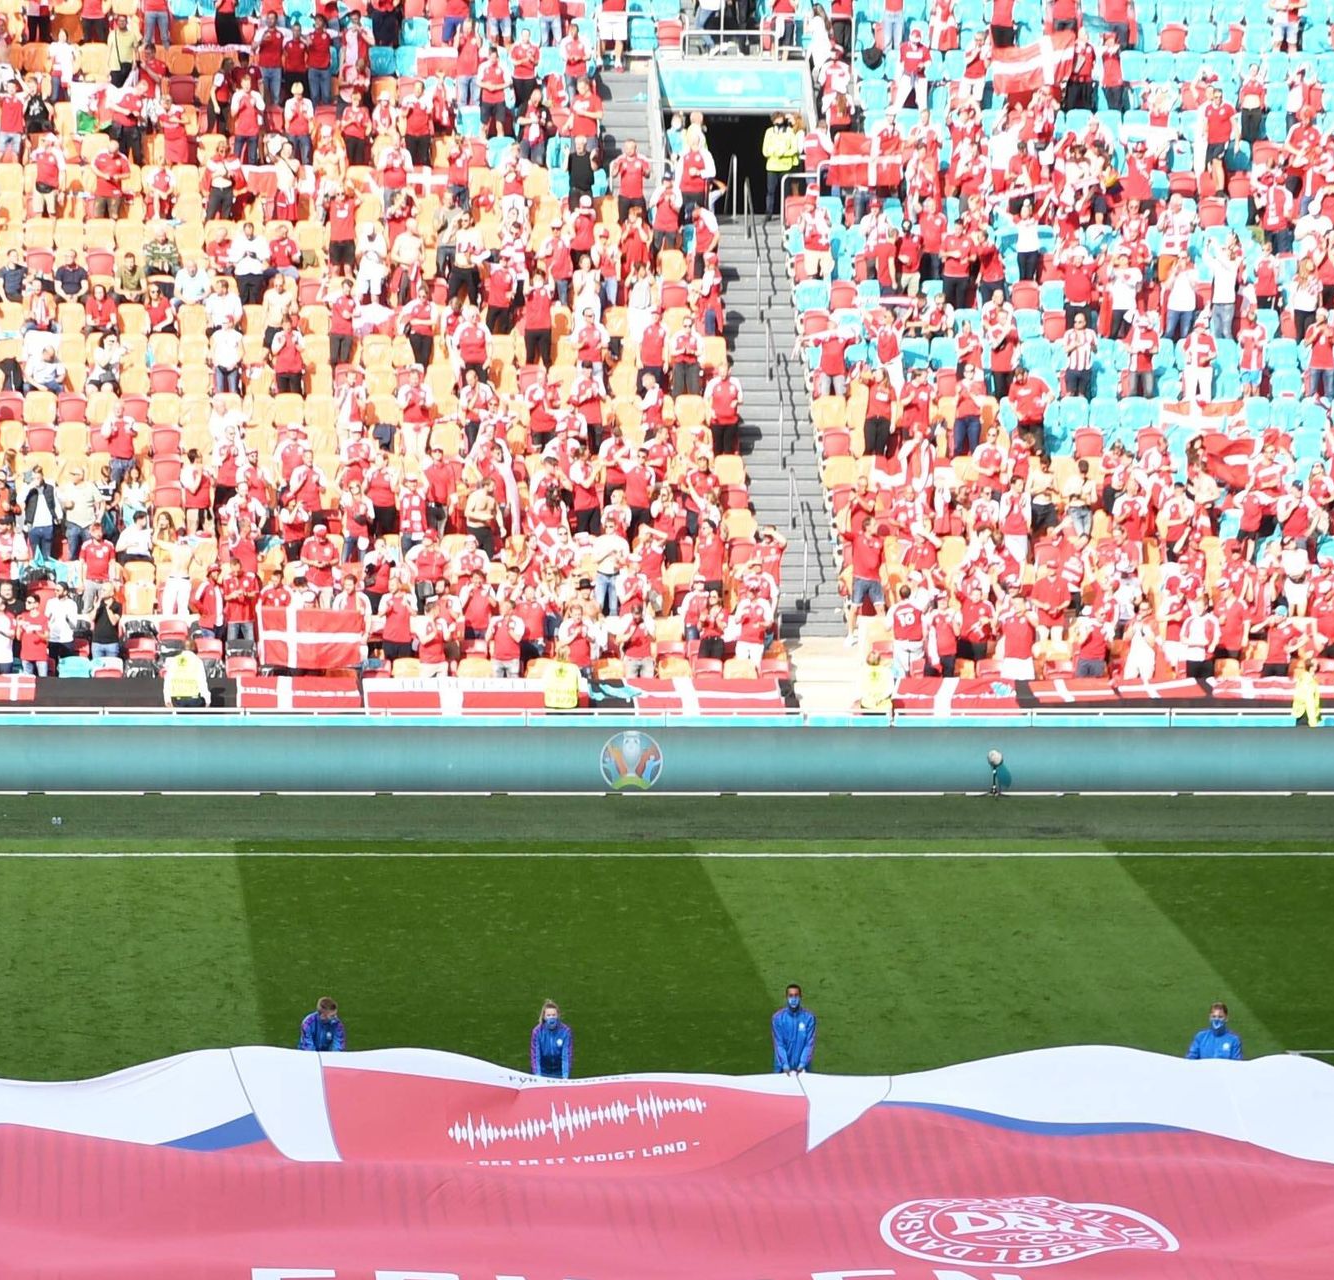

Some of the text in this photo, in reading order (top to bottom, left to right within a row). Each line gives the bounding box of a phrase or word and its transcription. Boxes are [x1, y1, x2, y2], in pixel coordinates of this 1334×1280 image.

[545, 1157, 566, 1165] ET
[573, 1149, 637, 1164] YNDIGT
[642, 1140, 688, 1158] LAND
[896, 1206, 977, 1259] DANSK
